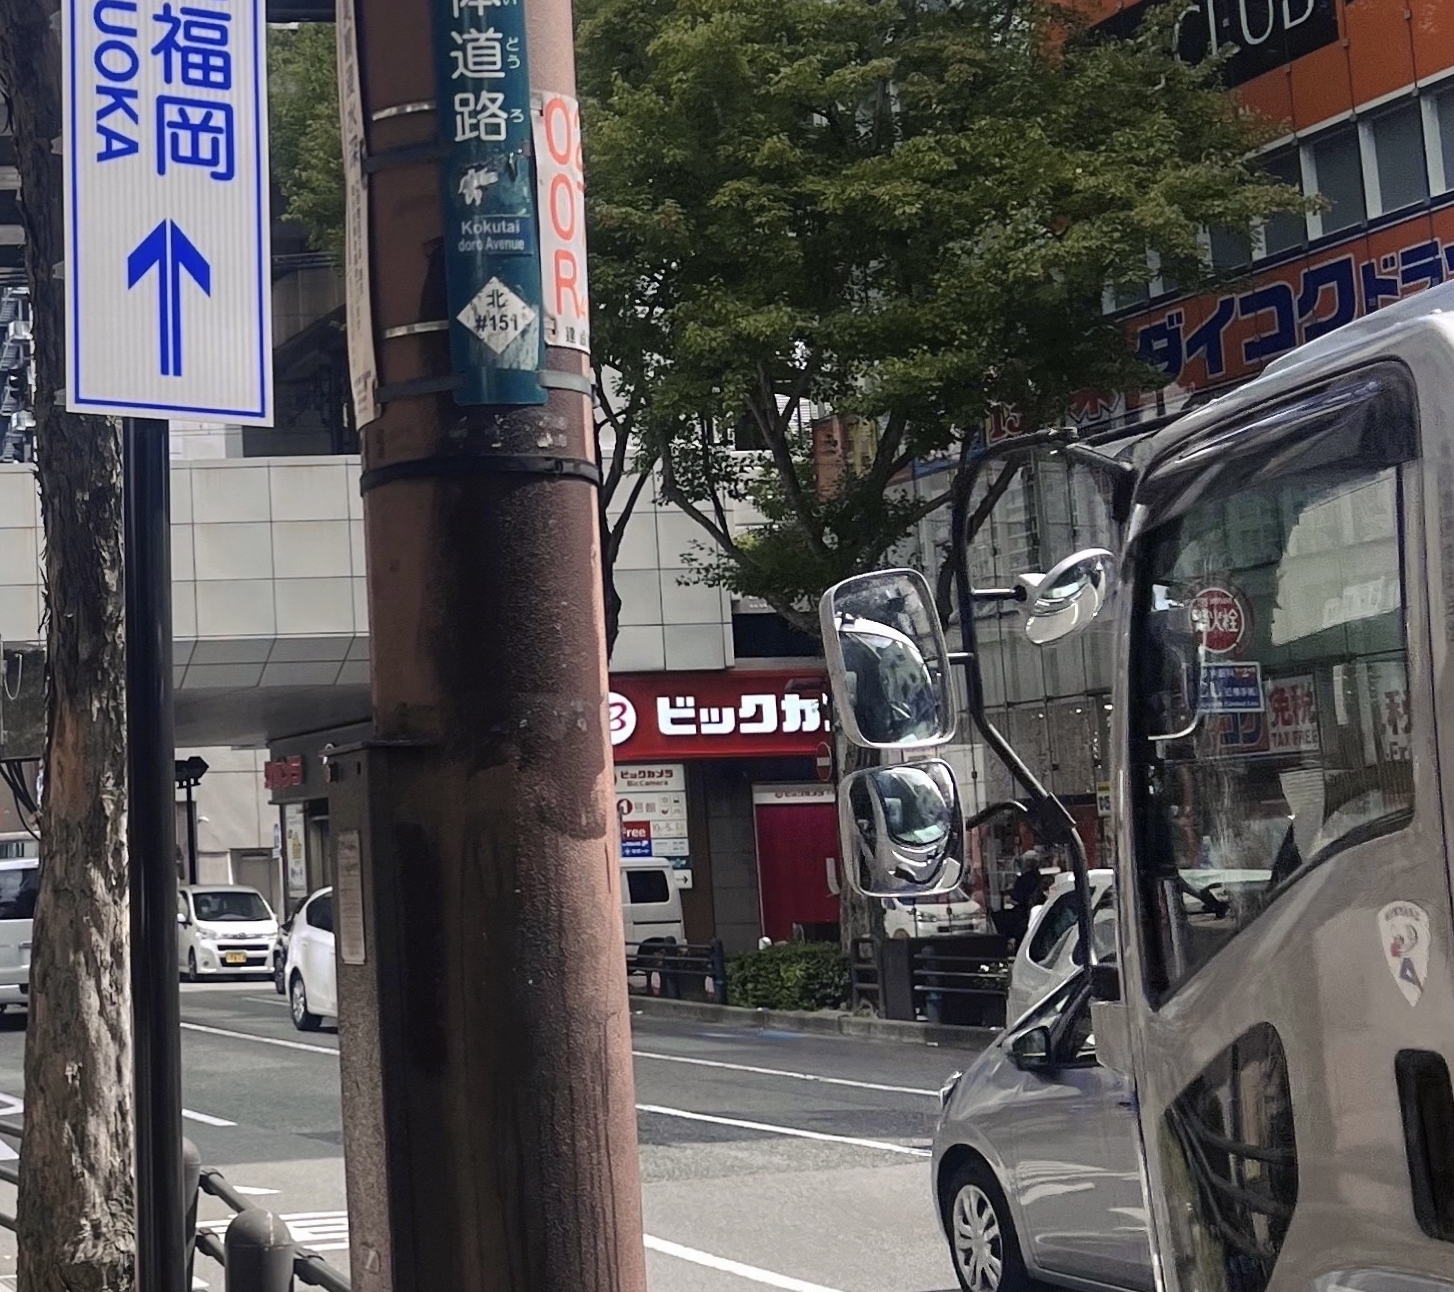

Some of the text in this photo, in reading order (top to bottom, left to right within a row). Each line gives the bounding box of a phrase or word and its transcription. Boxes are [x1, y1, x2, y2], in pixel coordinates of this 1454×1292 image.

[461, 219, 521, 235] Kokutai
[458, 237, 525, 253] doro Avenue
[620, 769, 674, 779] ビックカメラ
